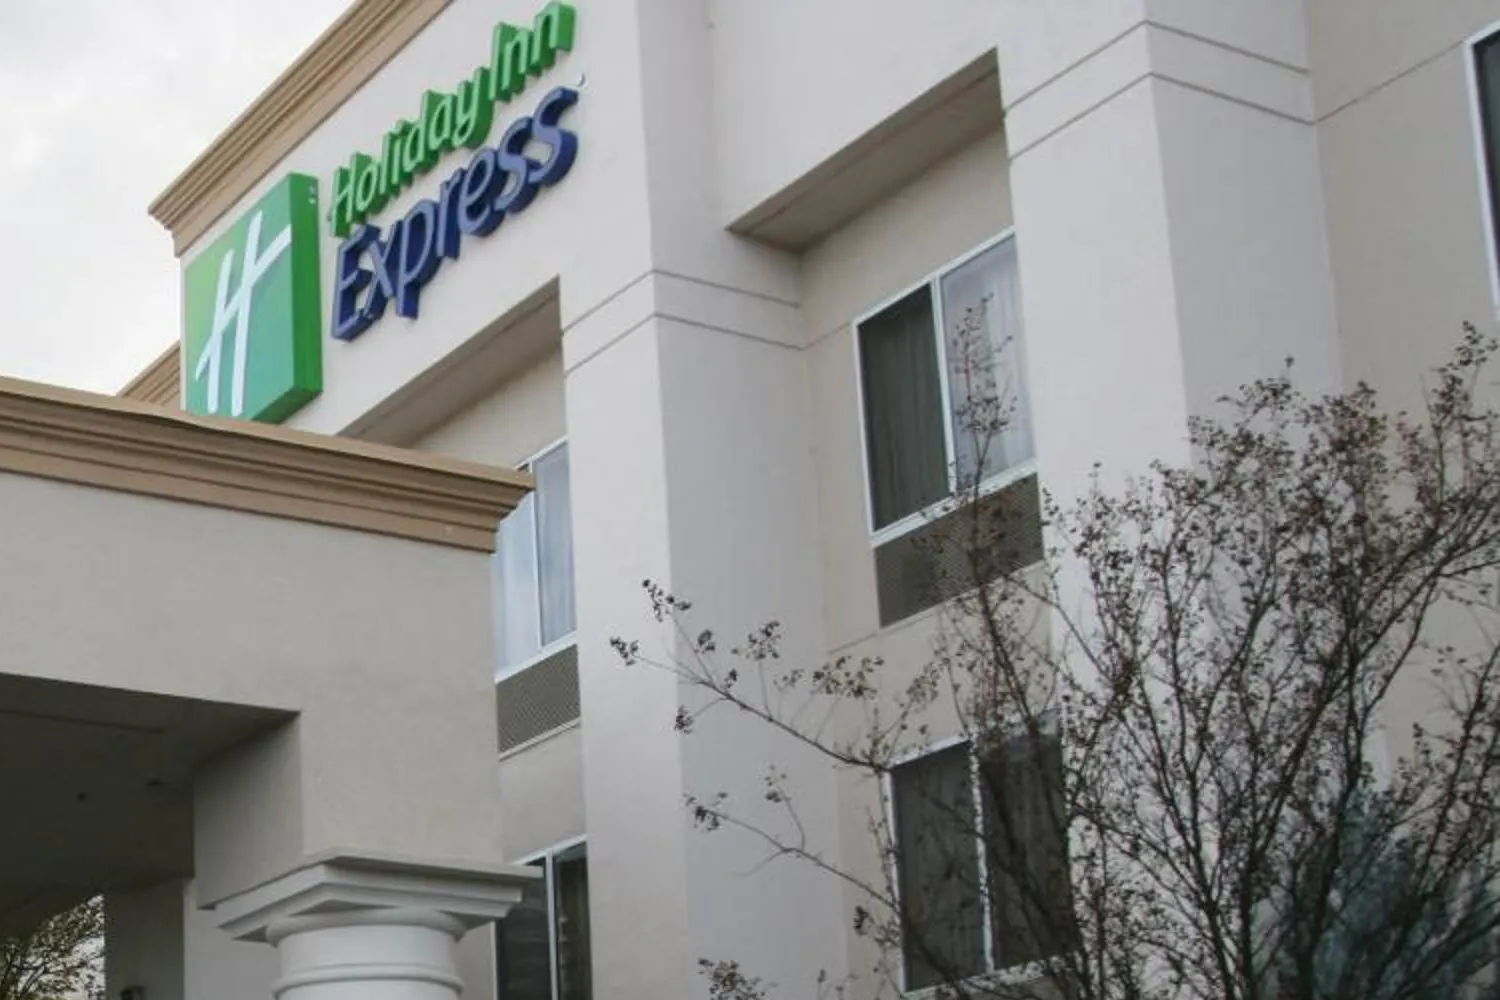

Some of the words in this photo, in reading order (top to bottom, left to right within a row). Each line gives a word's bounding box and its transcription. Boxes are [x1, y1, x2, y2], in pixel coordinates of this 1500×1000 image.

[330, 67, 496, 237] Holiday
[488, 1, 576, 103] Inn
[332, 86, 579, 342] Express
